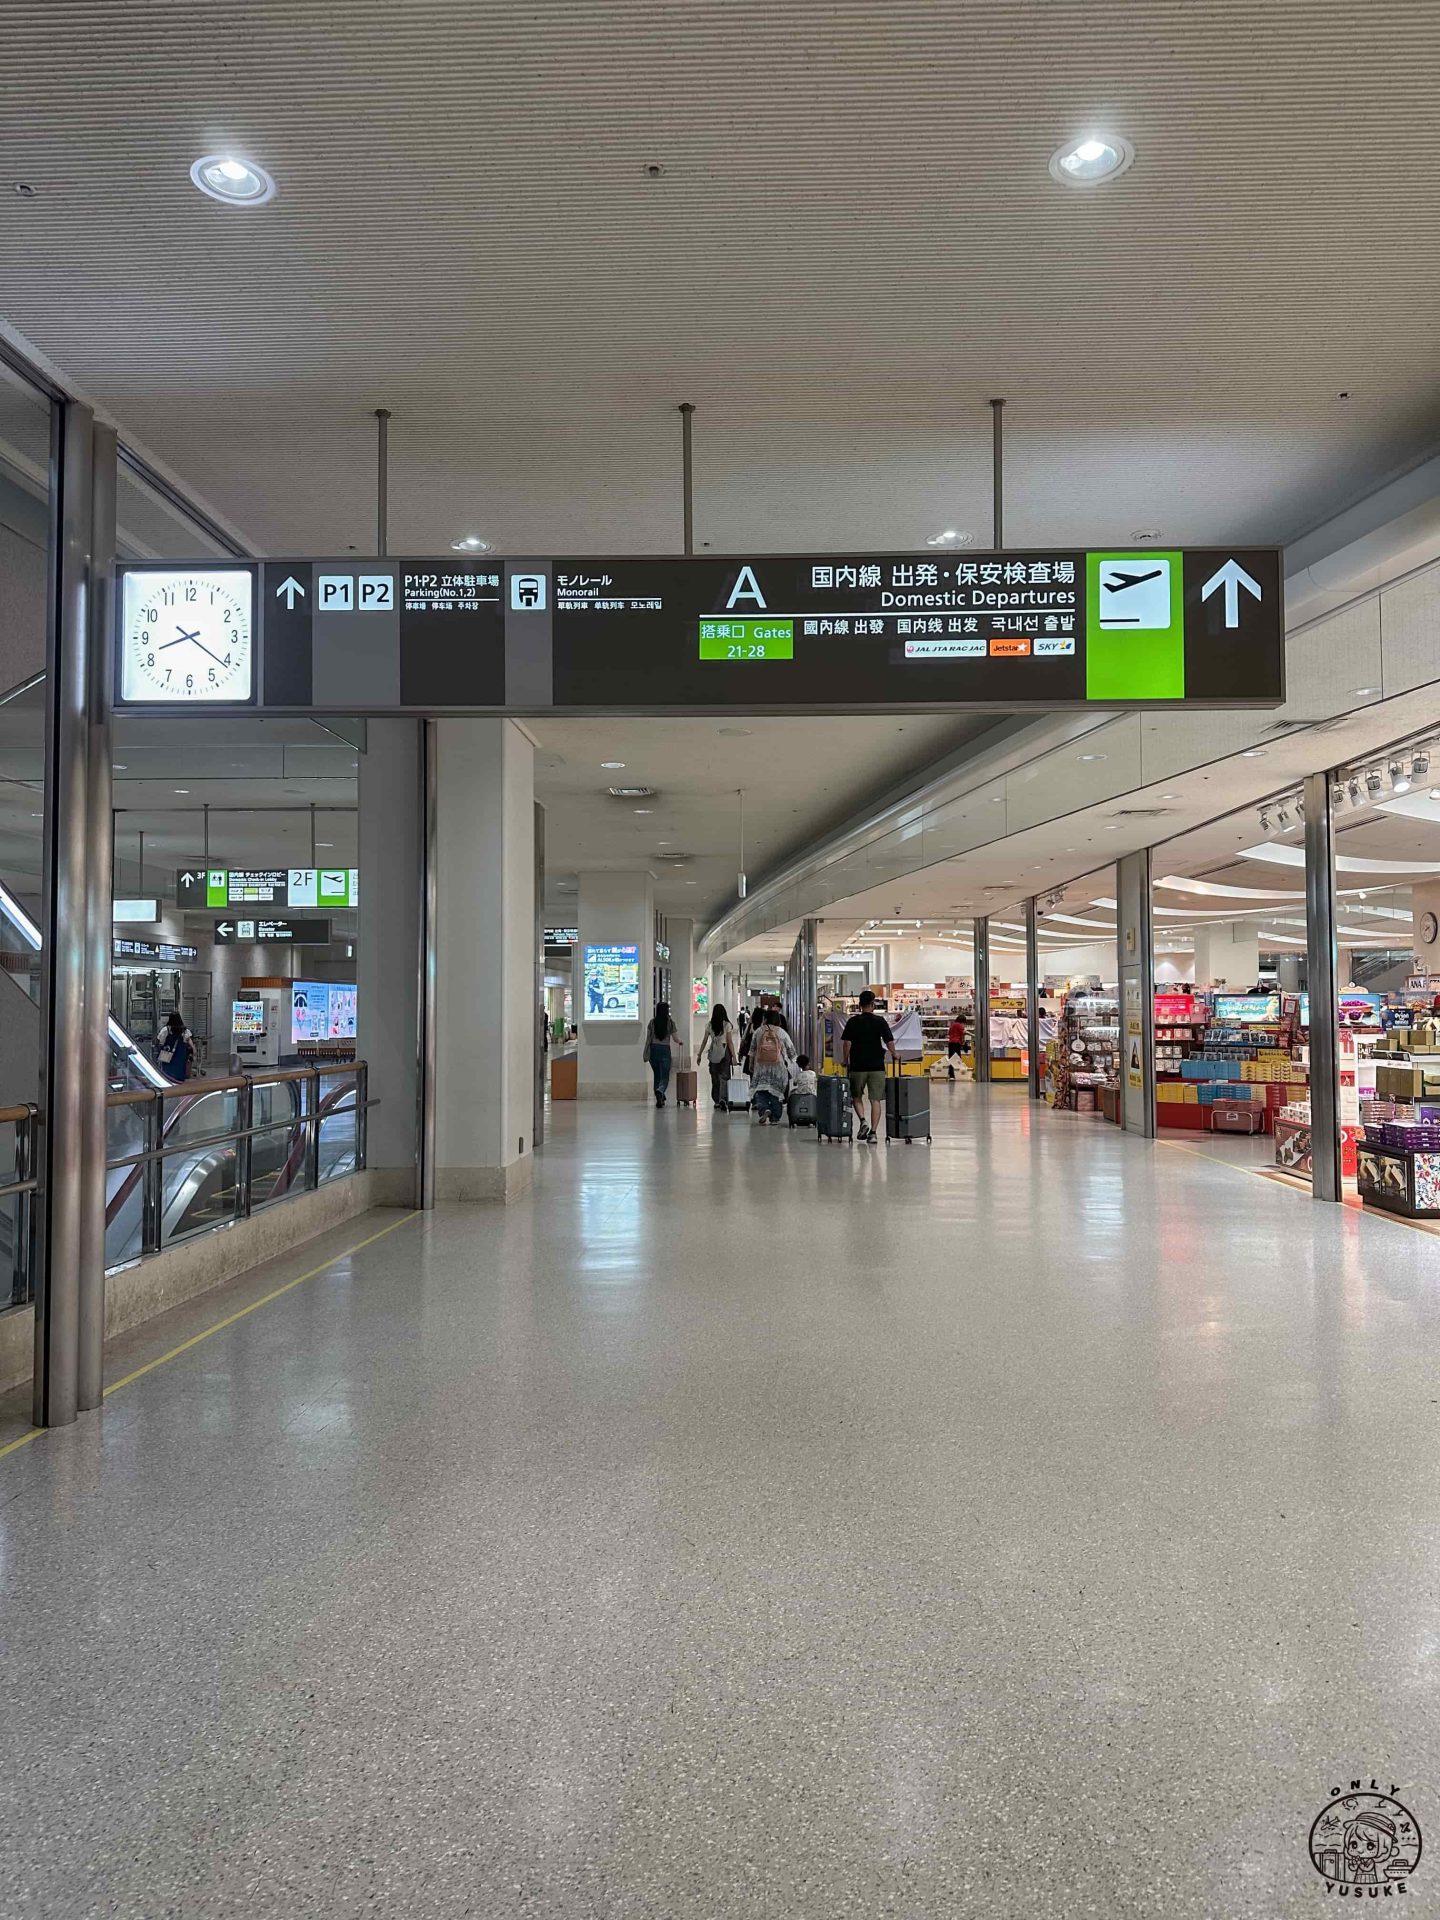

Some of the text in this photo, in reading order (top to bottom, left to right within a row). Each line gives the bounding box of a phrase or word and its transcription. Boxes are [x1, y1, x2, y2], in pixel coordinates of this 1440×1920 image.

[441, 575, 499, 587] 立体駐車場
[557, 575, 612, 586] モノレール
[812, 561, 1075, 588] 国内線 出発・保安検査場
[324, 584, 389, 602] P1 P2
[557, 588, 598, 596] Monorail
[726, 566, 767, 609] A
[165, 592, 174, 606] 11
[186, 588, 197, 601] 12
[881, 589, 1075, 608] Domestic Departures
[630, 601, 662, 609] 모노레일
[147, 609, 158, 622] 10
[224, 609, 231, 622] 2
[804, 619, 885, 635] 國內線 出發
[897, 617, 979, 634] 国内线 出发
[991, 615, 1075, 632] 국내선 출발
[141, 631, 149, 644] 9
[231, 630, 238, 643] 3
[701, 624, 791, 639] 搭乗口 Gates
[727, 645, 765, 657] 21-28
[147, 653, 155, 666] 8
[224, 653, 231, 665] 4
[165, 669, 172, 682] 7
[186, 674, 193, 688] 6
[208, 668, 215, 681] 5
[293, 872, 313, 886] 2F
